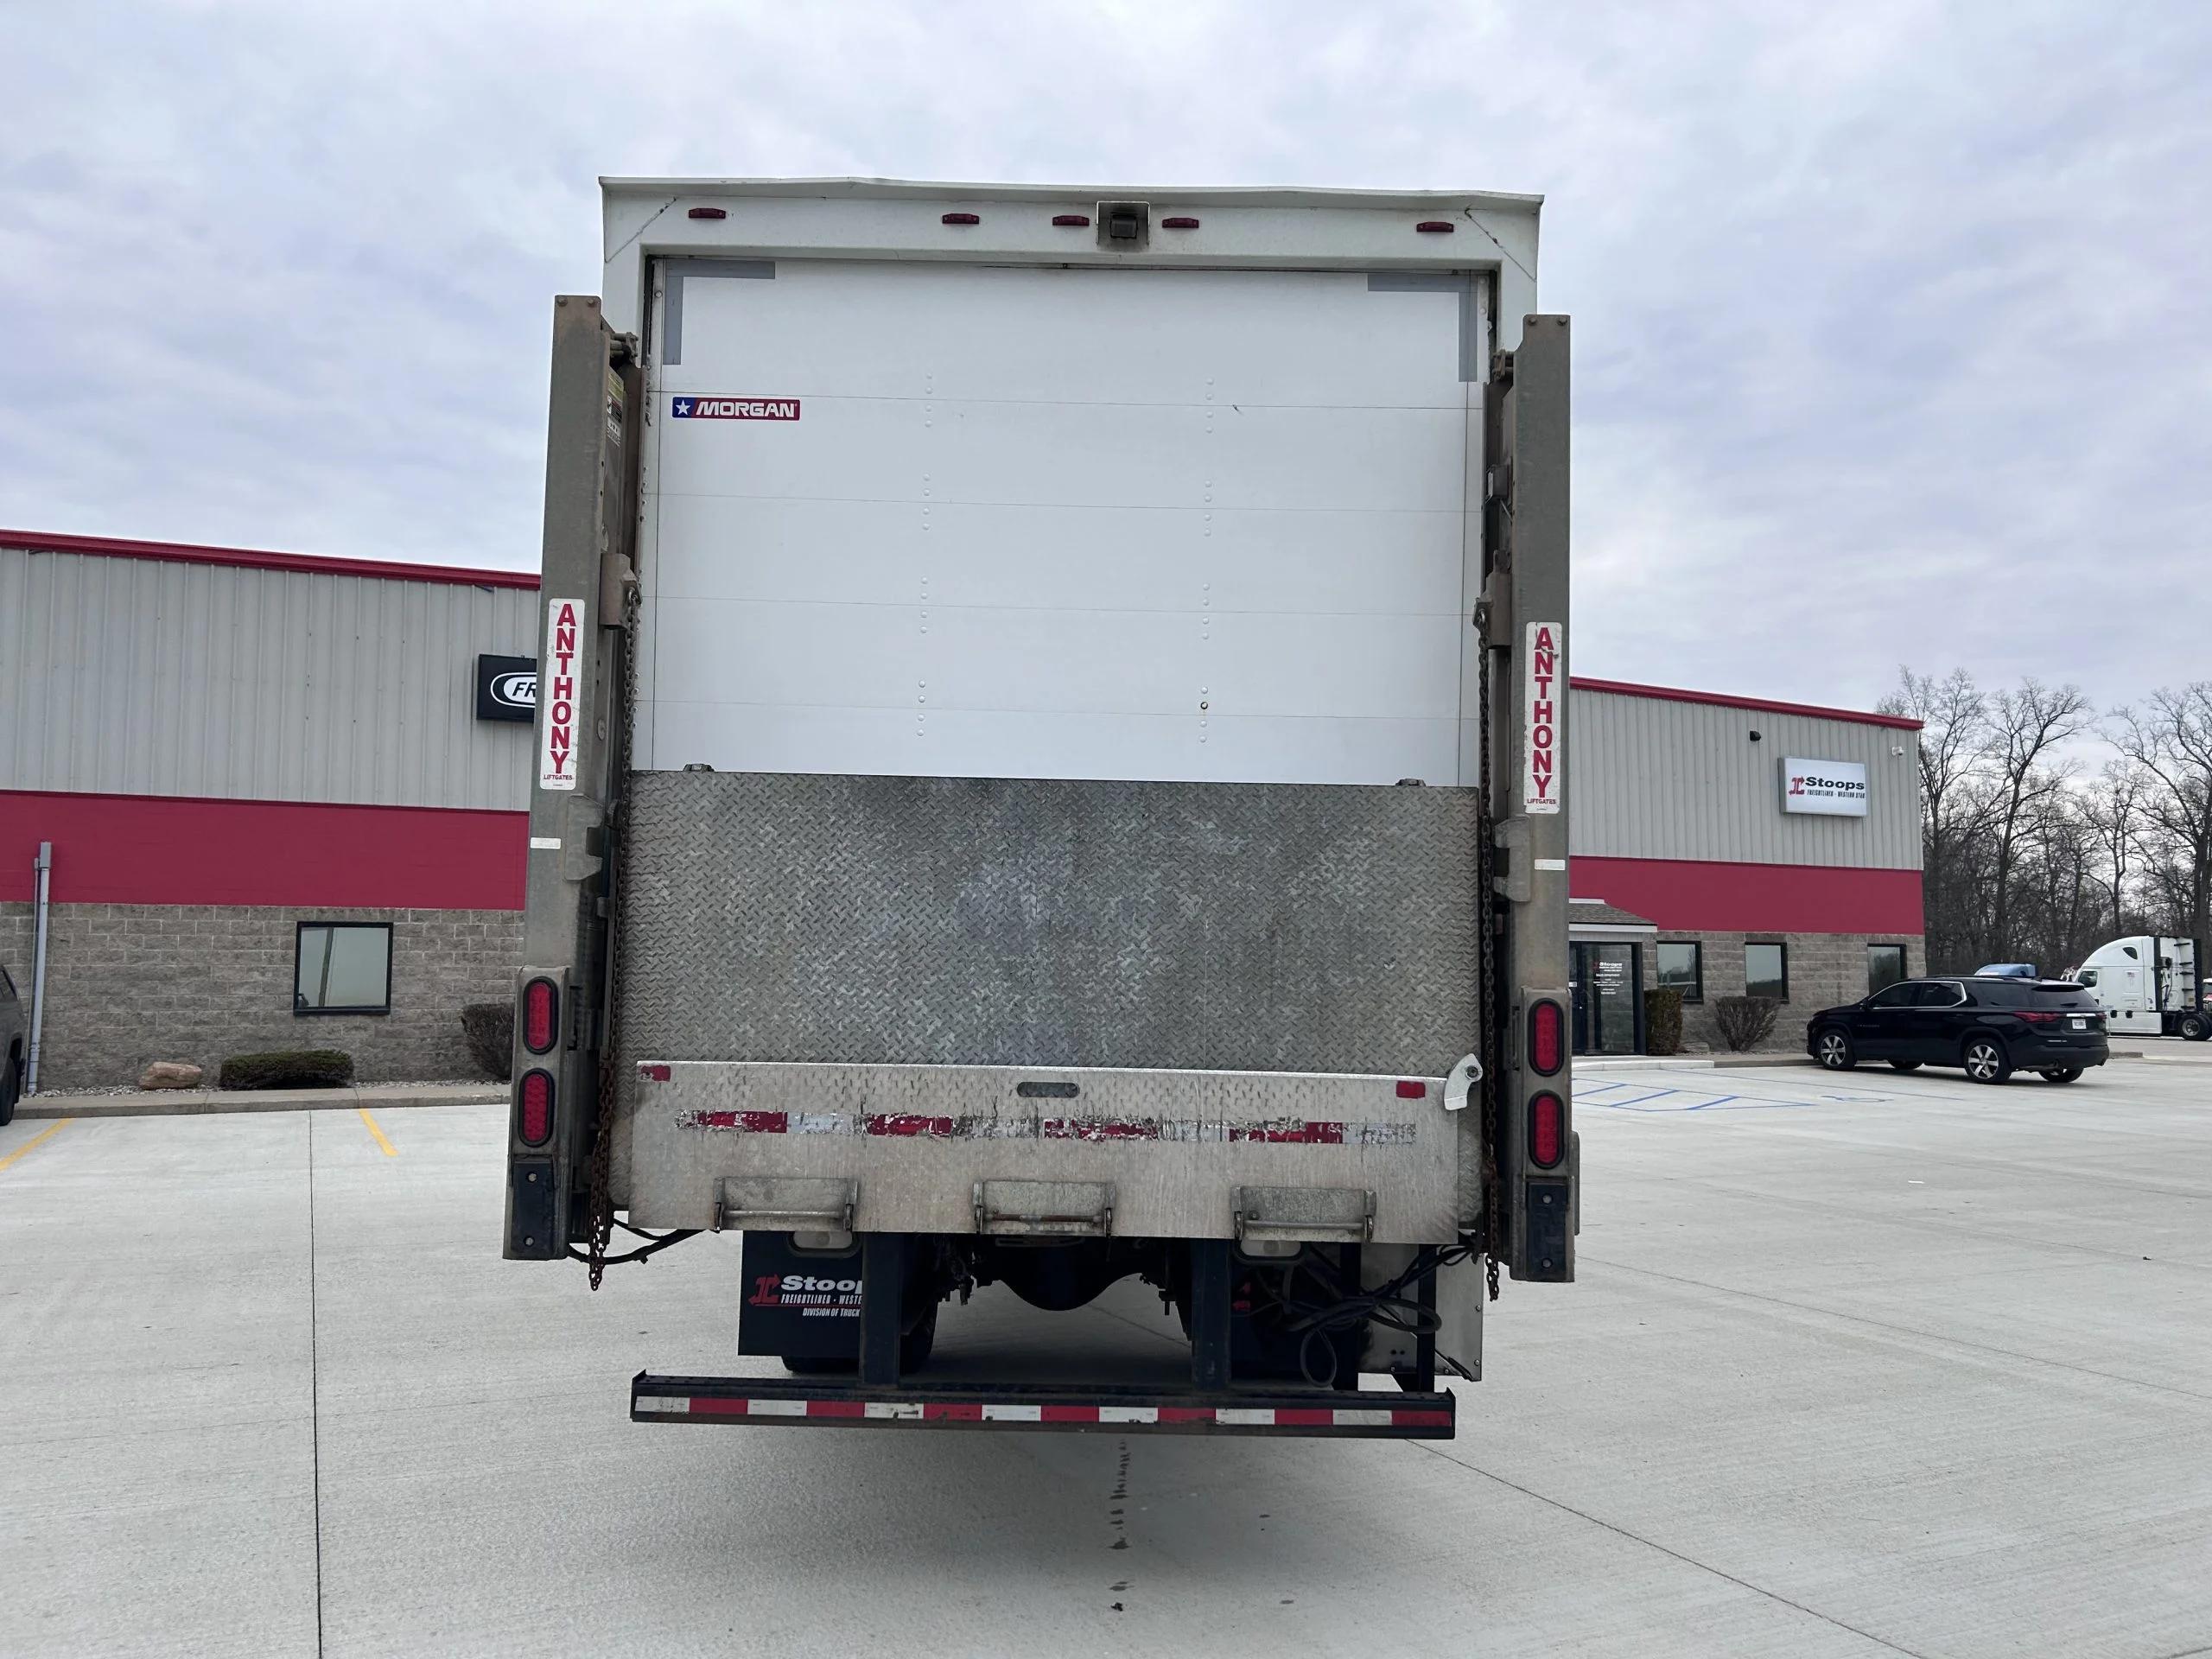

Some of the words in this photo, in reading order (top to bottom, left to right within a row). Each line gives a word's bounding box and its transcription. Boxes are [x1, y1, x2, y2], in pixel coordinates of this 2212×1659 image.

[696, 401, 794, 417] MORGAN
[550, 603, 576, 774] ANTHONY
[1532, 627, 1554, 798] ANTHONY
[1805, 776, 1865, 791] Stoops
[781, 1294, 831, 1304] FREIGHTLINER
[803, 1307, 830, 1317] DIVISION
[830, 1307, 839, 1317] OF
[840, 1308, 861, 1318] TRUCK
